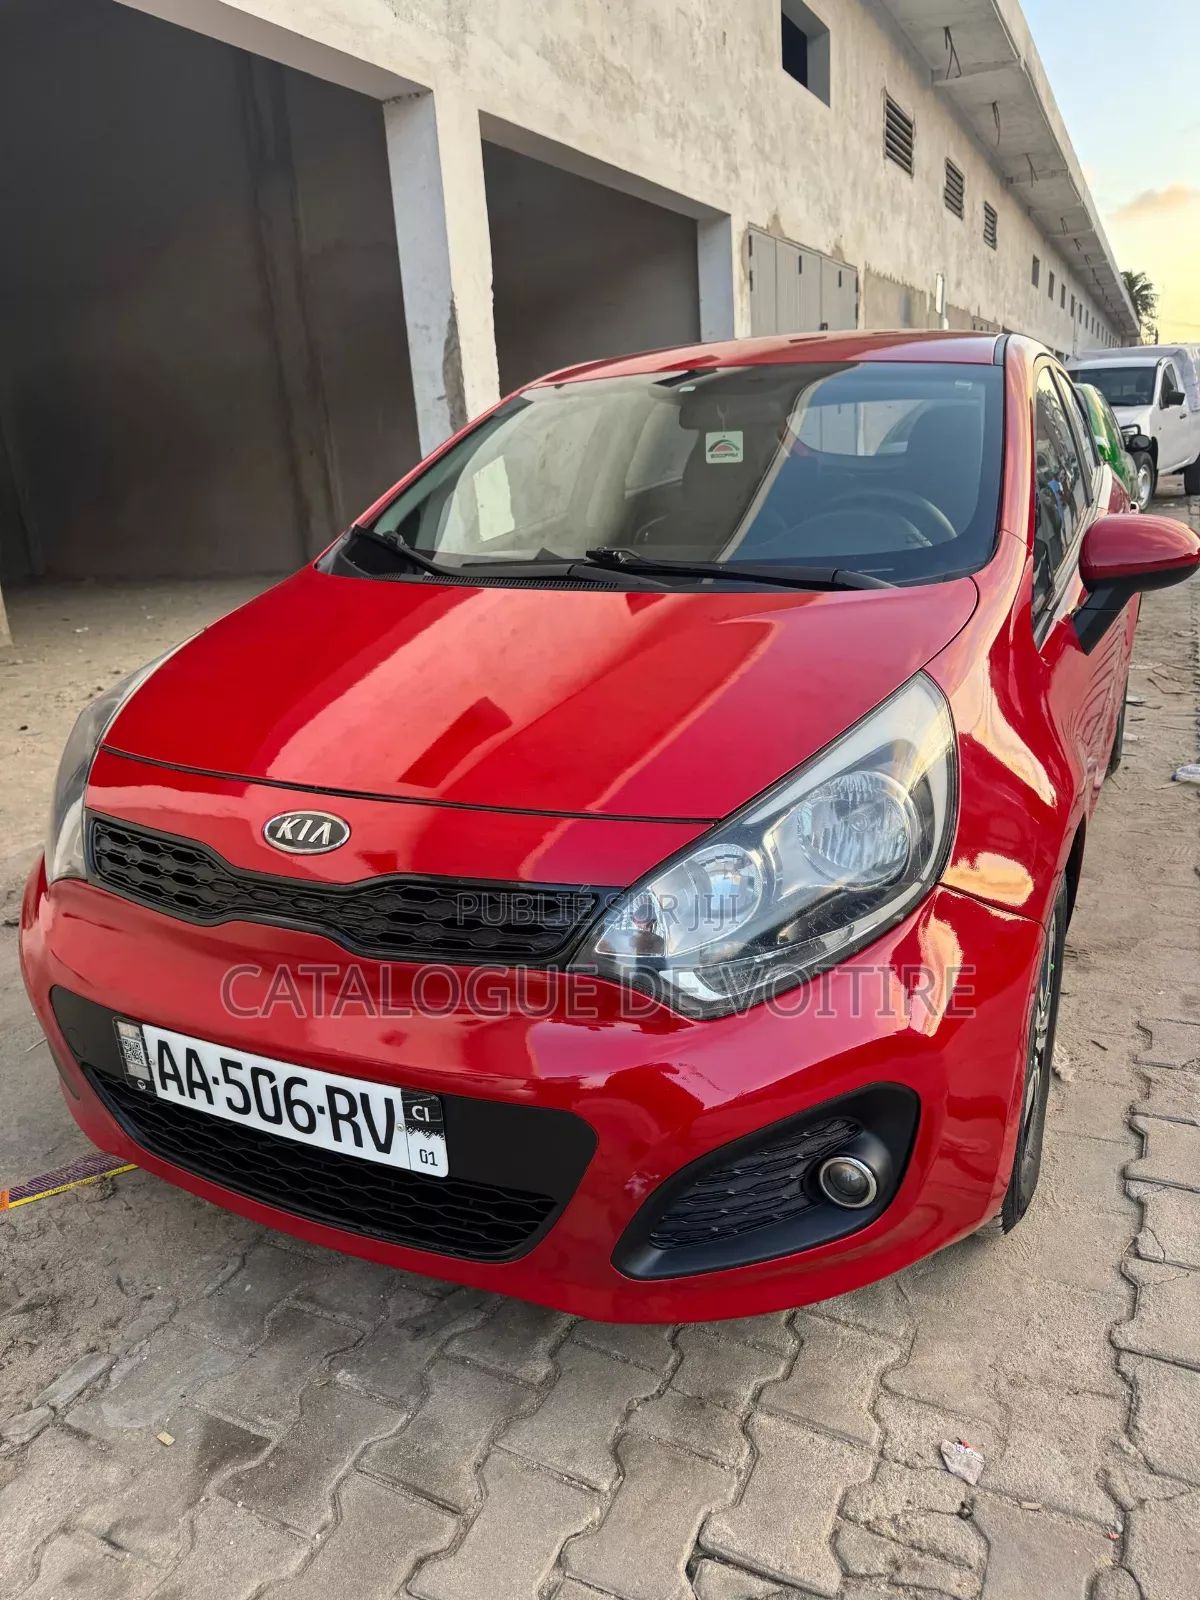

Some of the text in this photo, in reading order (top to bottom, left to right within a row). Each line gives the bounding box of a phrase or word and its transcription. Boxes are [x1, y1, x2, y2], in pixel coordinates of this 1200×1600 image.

[275, 817, 332, 845] KIA
[411, 1105, 430, 1122] CI
[419, 1148, 439, 1167] 01
